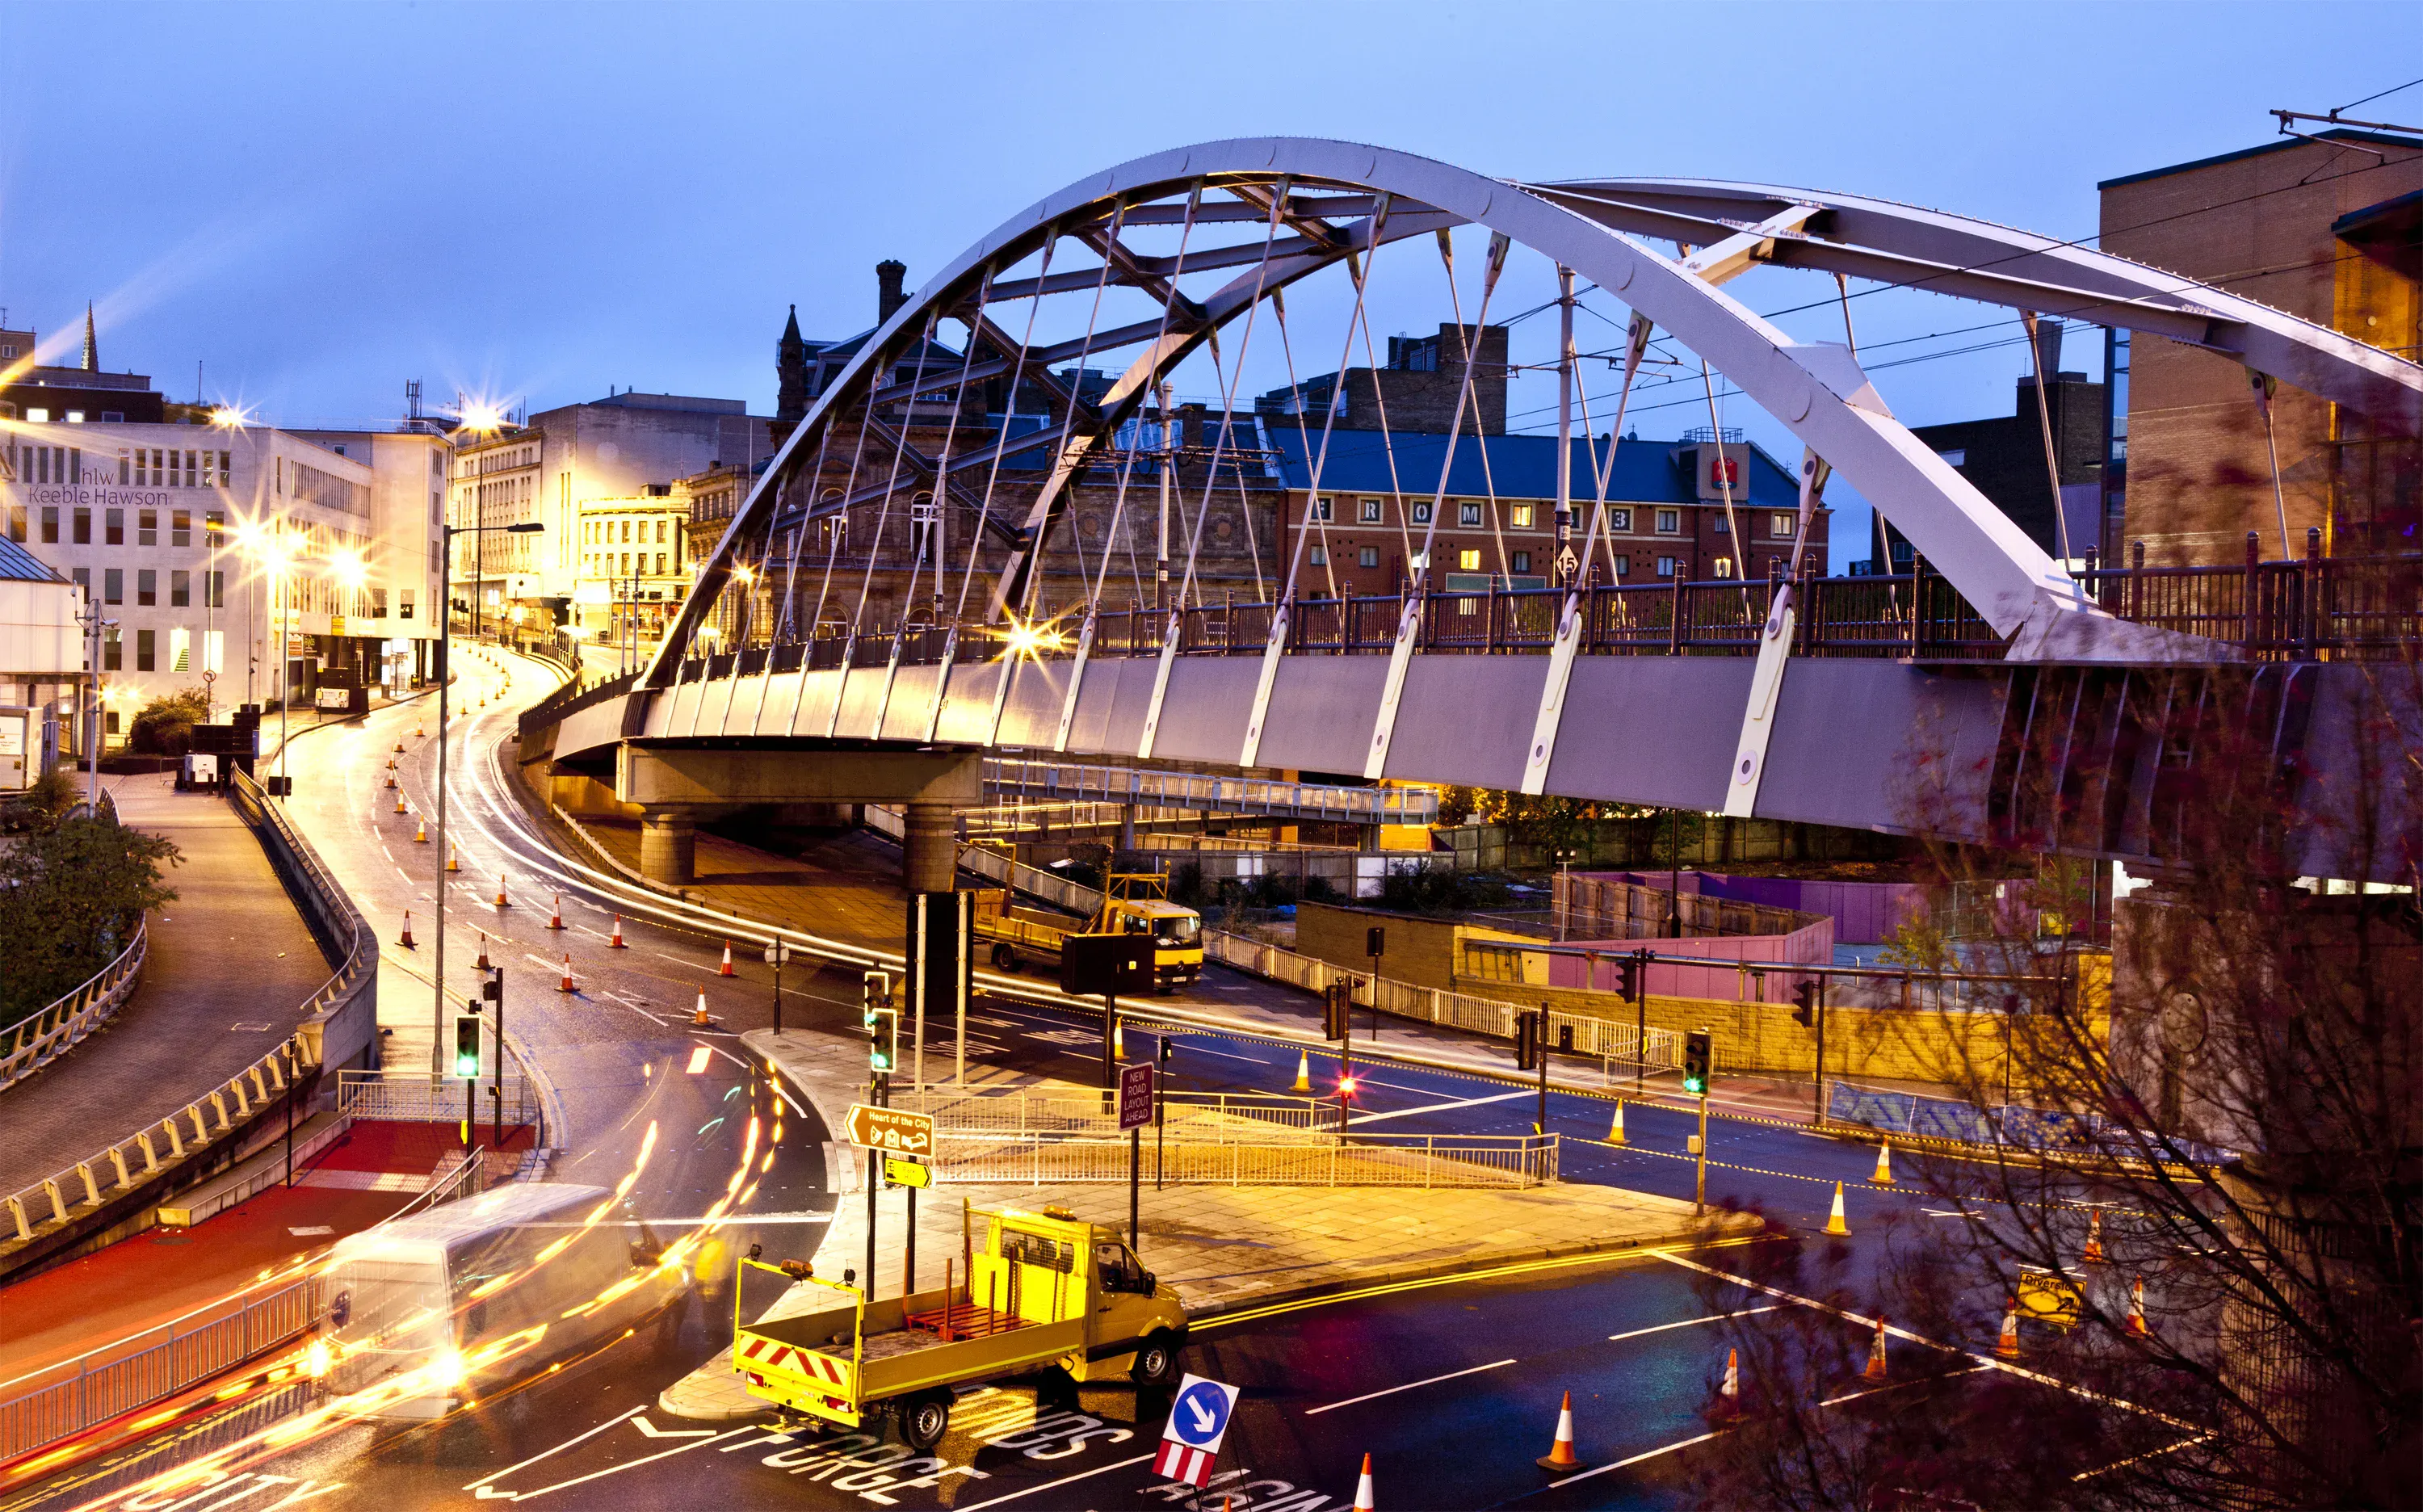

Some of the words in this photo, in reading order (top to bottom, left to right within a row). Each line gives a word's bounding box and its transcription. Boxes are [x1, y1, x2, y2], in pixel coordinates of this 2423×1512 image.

[82, 468, 114, 485] hlw
[29, 487, 90, 504] Keeble
[94, 488, 168, 506] Hawson
[1559, 557, 1575, 572] 15
[1129, 1070, 1145, 1083] NEW
[1128, 1083, 1147, 1097] ROAD
[1124, 1095, 1149, 1111] LAYOUT
[869, 1111, 890, 1123] Heart
[891, 1115, 900, 1124] of
[901, 1116, 913, 1127] the
[914, 1119, 930, 1131] City
[1124, 1108, 1149, 1123] AHEAD
[2025, 1275, 2074, 1292] Diversio
